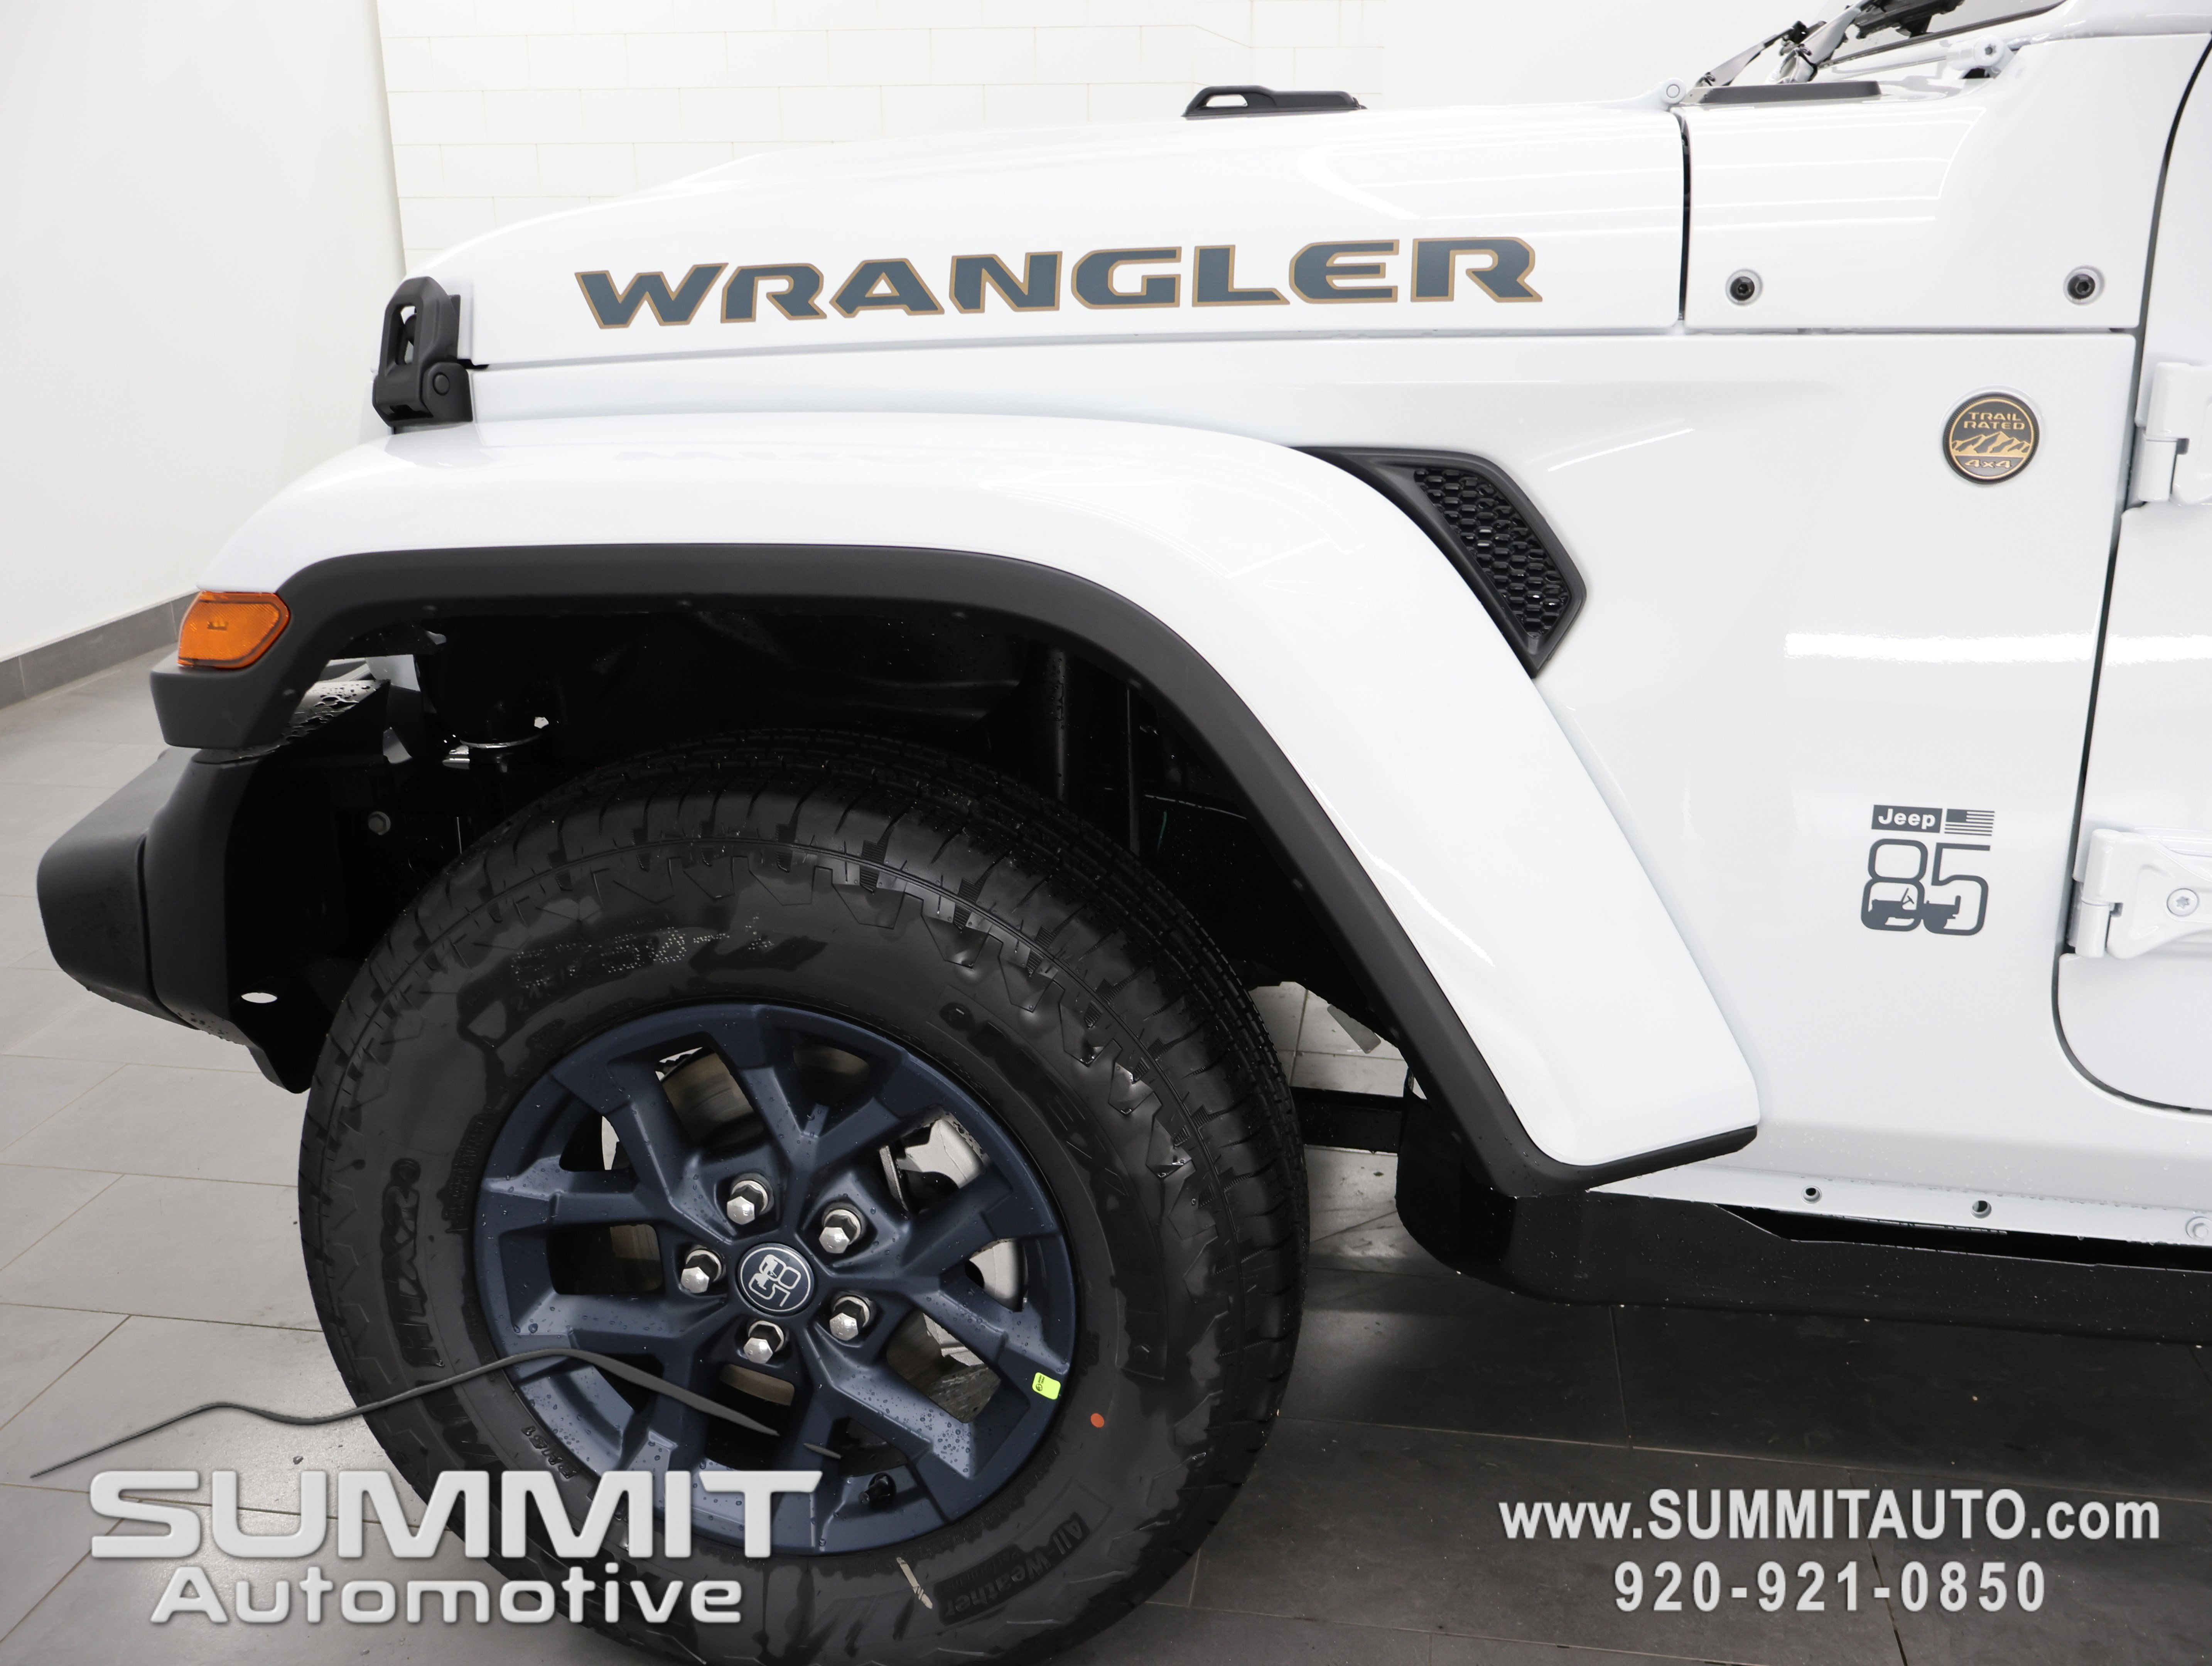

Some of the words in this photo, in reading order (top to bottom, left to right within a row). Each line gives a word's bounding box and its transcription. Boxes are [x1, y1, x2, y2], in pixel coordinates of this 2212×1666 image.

[574, 236, 1543, 329] WRANGLER
[1964, 421, 2025, 430] RATED
[1969, 412, 2021, 421] TRAIL
[1965, 459, 2011, 469] 4x4
[1878, 808, 1936, 830] Jeep
[1861, 838, 1991, 936] 85
[943, 1518, 1085, 1617] All-Weather
